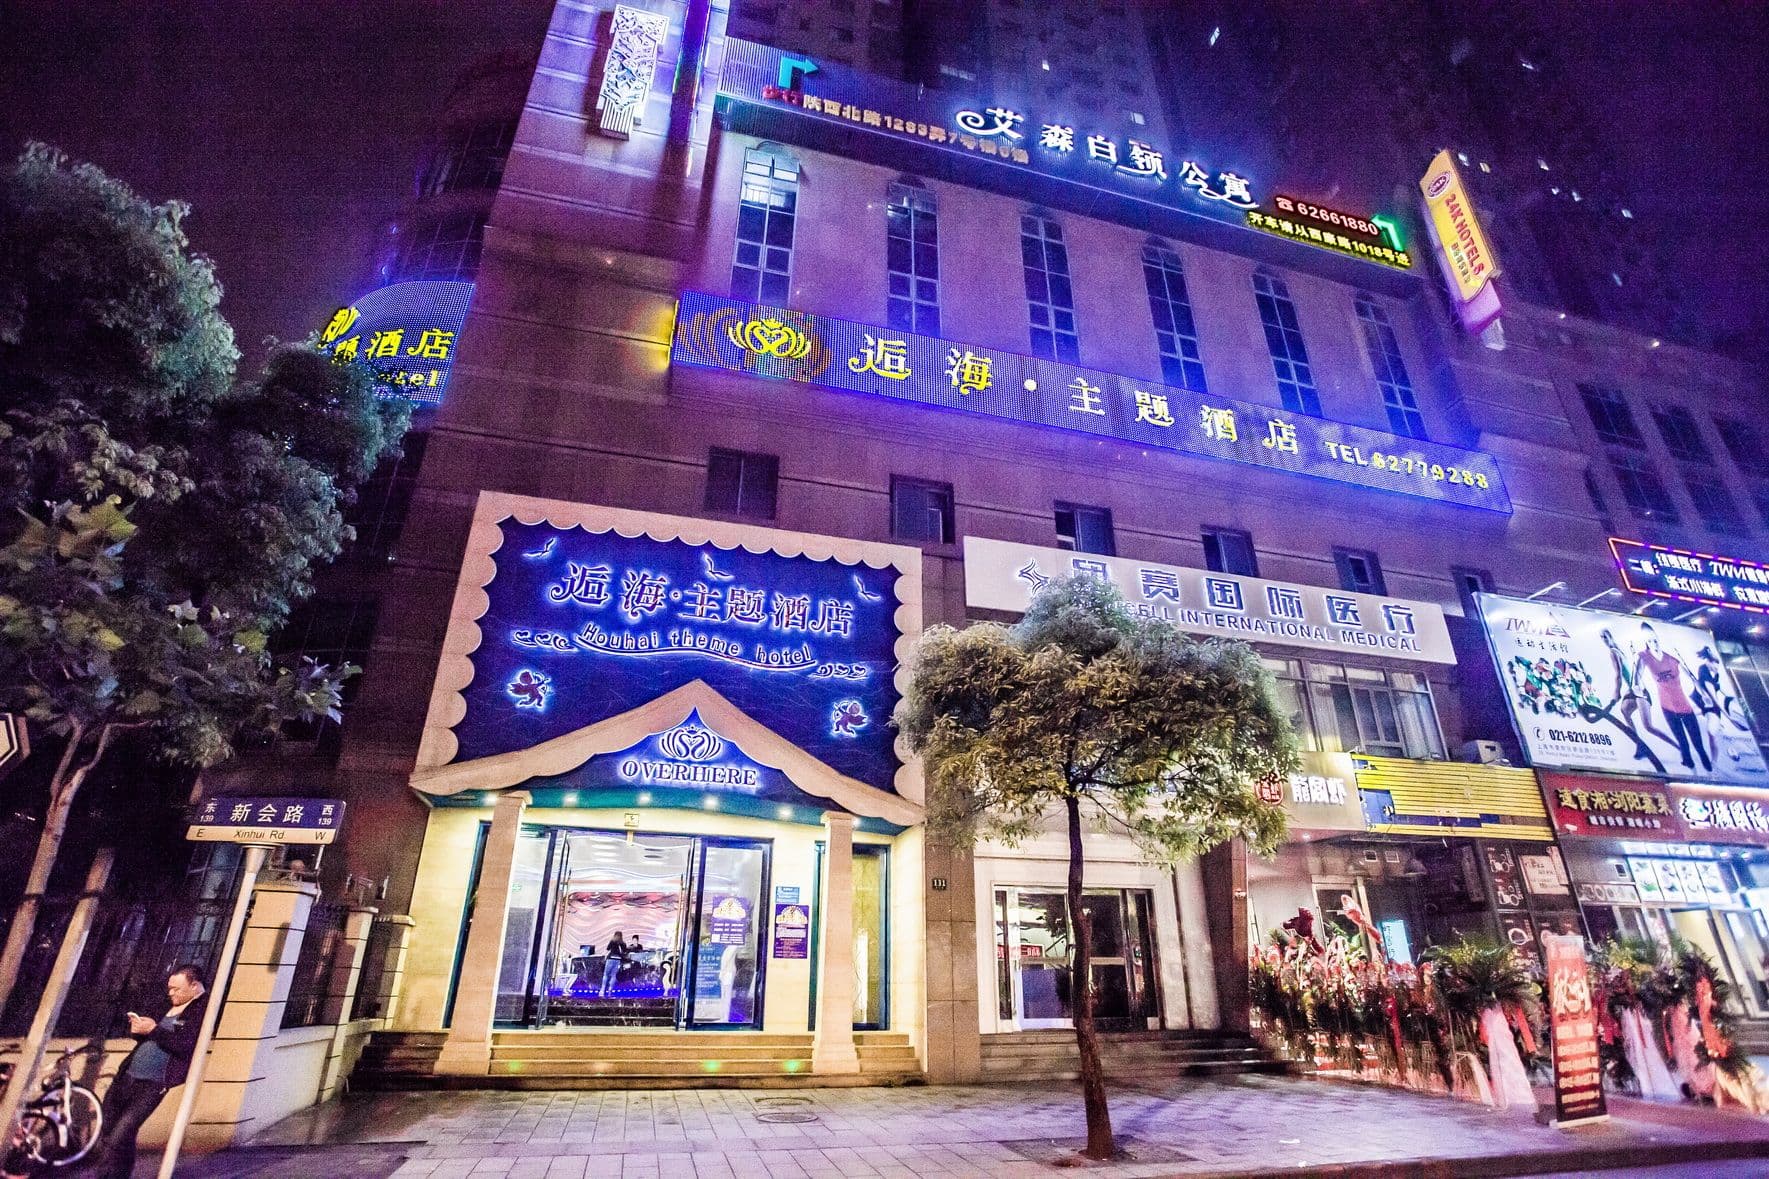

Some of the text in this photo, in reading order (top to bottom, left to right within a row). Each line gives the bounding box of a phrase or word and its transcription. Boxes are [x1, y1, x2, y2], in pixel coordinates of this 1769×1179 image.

[1297, 203, 1380, 237] 62661880
[1455, 219, 1486, 276] HOTELS
[1325, 441, 1489, 489] TEL 62779288
[582, 623, 812, 666] Houhai theme hotel
[1180, 609, 1335, 641] INTERNATIONAL
[1341, 630, 1422, 652] MEDICAL
[1548, 729, 1613, 746] 021-6212 8896
[621, 760, 759, 787] OVERHERE
[205, 803, 335, 823] 东 新会路 西
[196, 828, 205, 838] E
[234, 830, 265, 839] Xinhui
[315, 831, 327, 840] W
